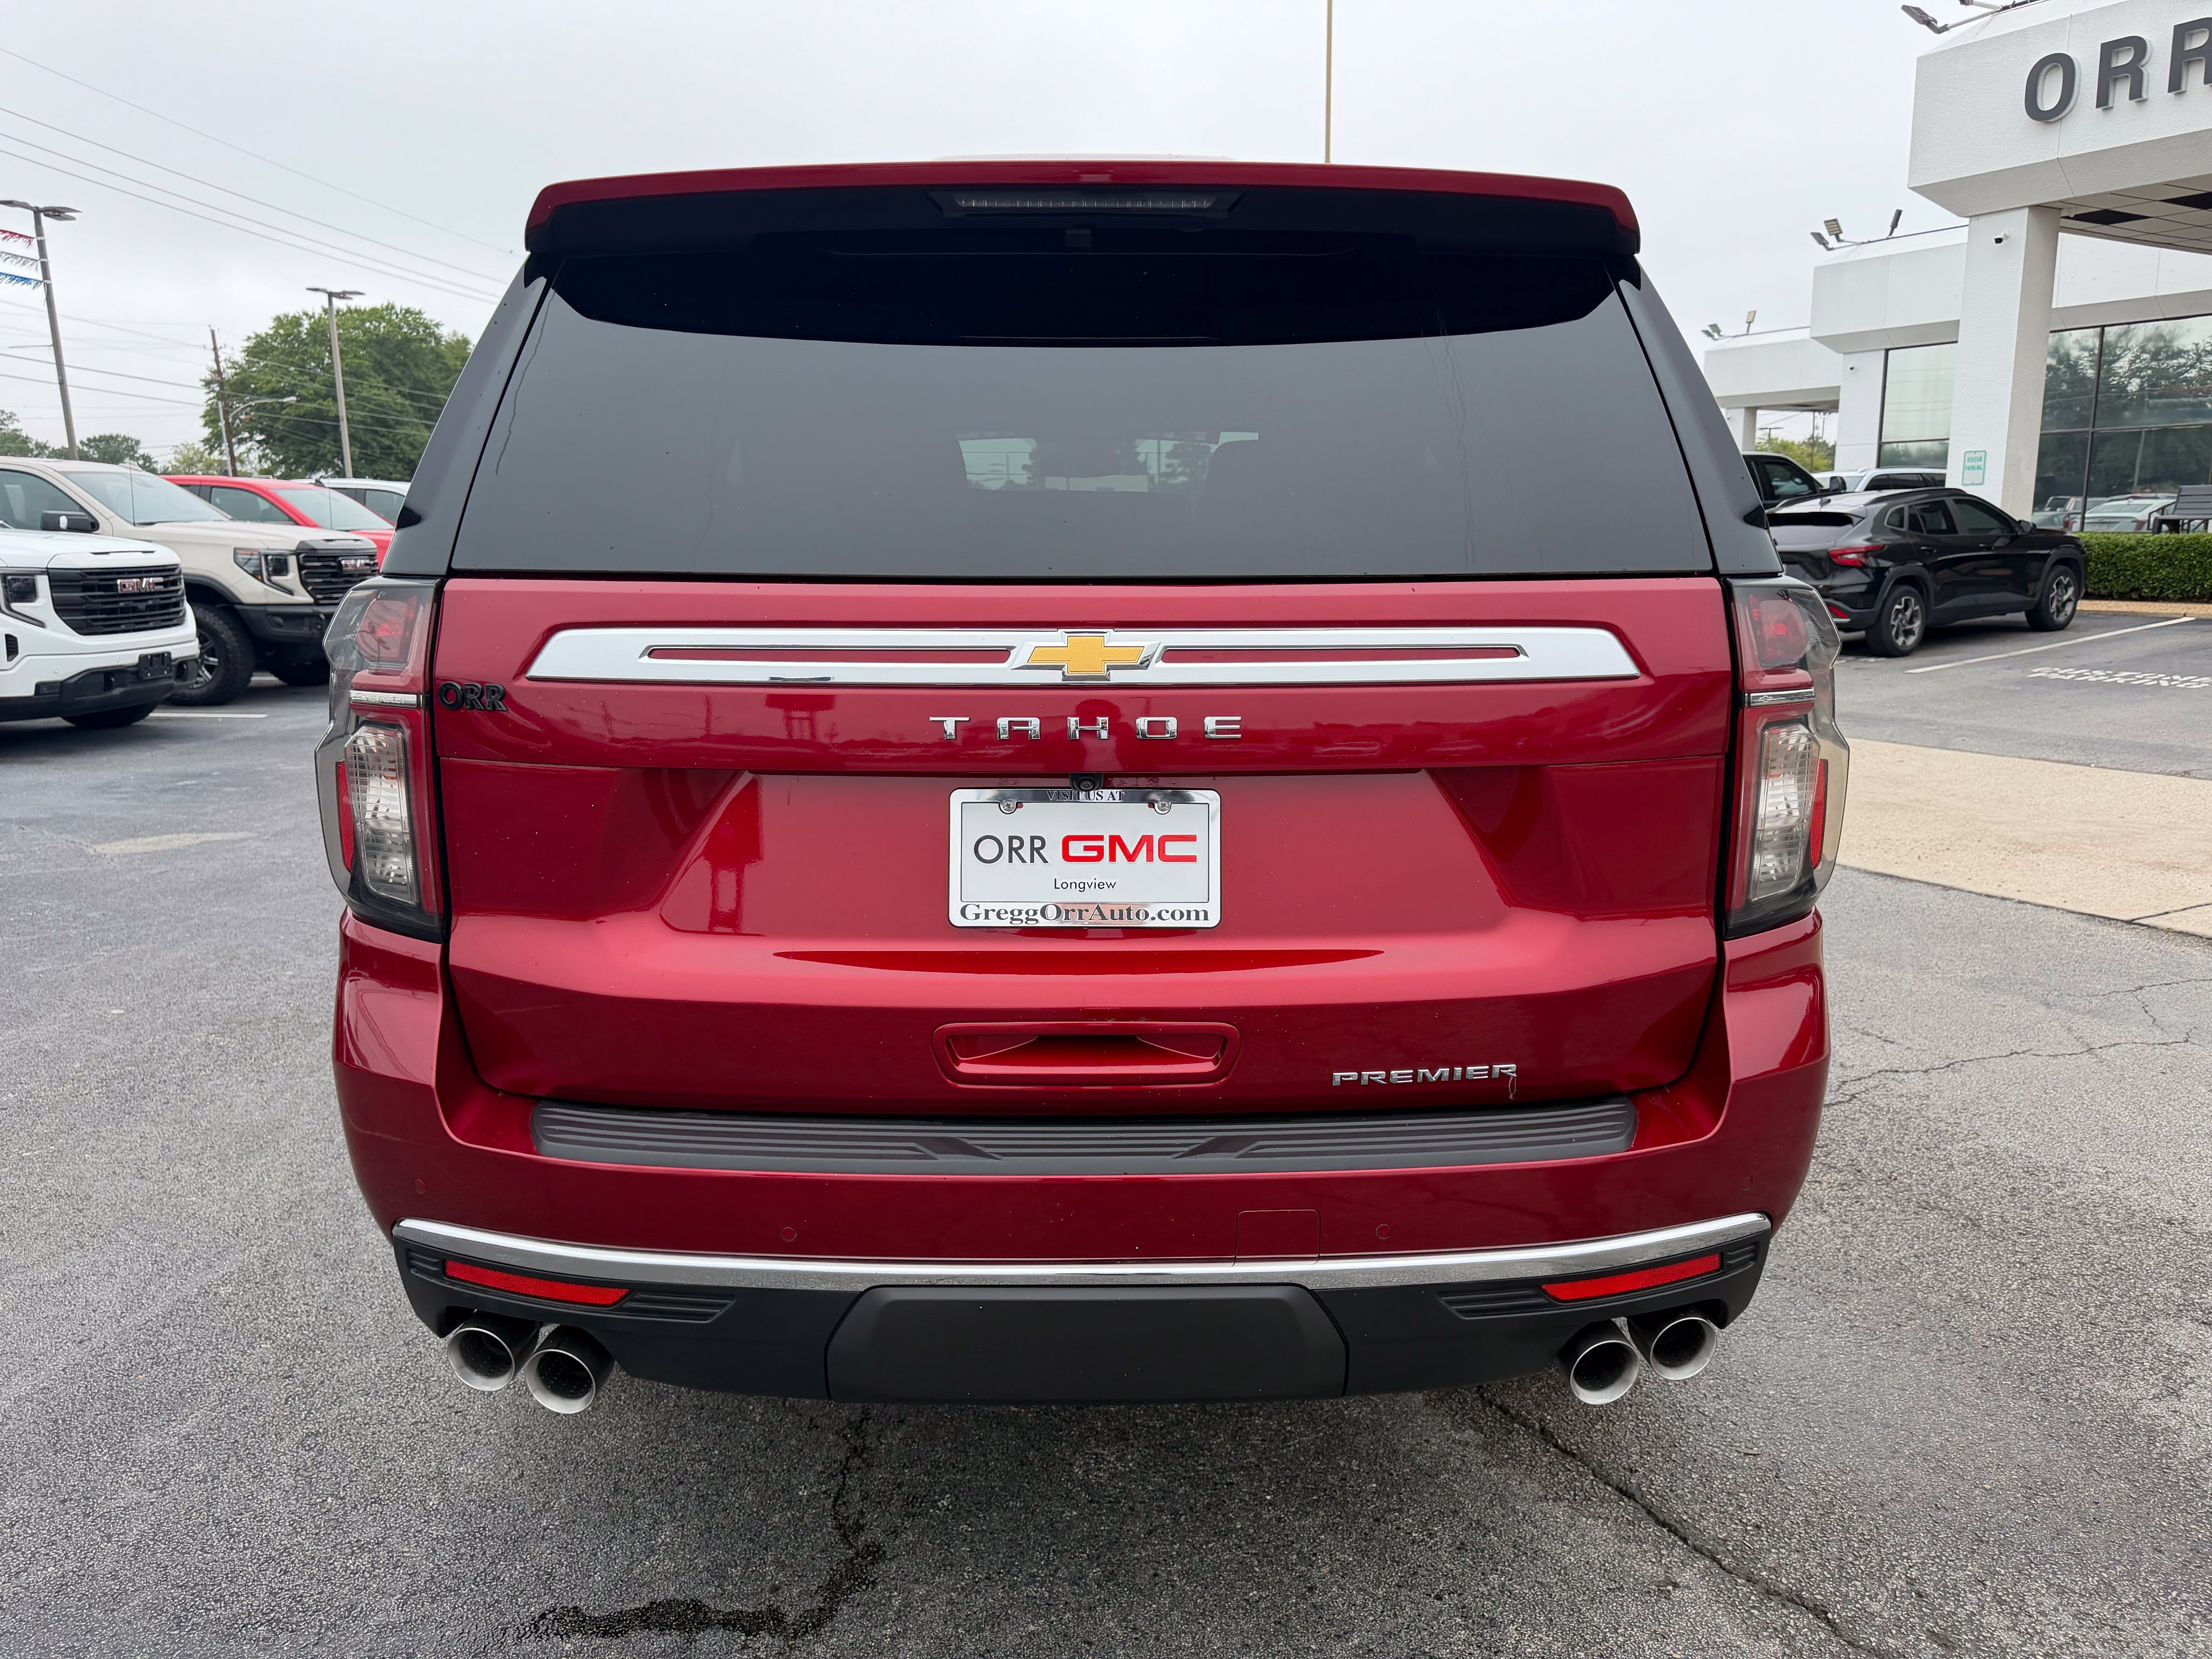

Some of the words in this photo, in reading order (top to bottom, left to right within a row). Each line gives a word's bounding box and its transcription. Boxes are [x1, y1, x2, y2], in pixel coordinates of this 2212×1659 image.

[2025, 17, 2212, 123] ORR
[341, 559, 370, 571] GMC
[117, 577, 164, 594] GMC
[438, 681, 509, 712] ORR
[929, 716, 1242, 740] TAHOE
[1046, 790, 1083, 801] VISIT
[1087, 790, 1103, 801] US
[1107, 790, 1125, 801] AT
[974, 835, 1049, 864] ORR
[1062, 834, 1197, 862] GMC
[1054, 878, 1116, 892] Longview
[960, 903, 1210, 925] GreggOrrAuto.com
[1332, 1064, 1517, 1086] PREMIER
